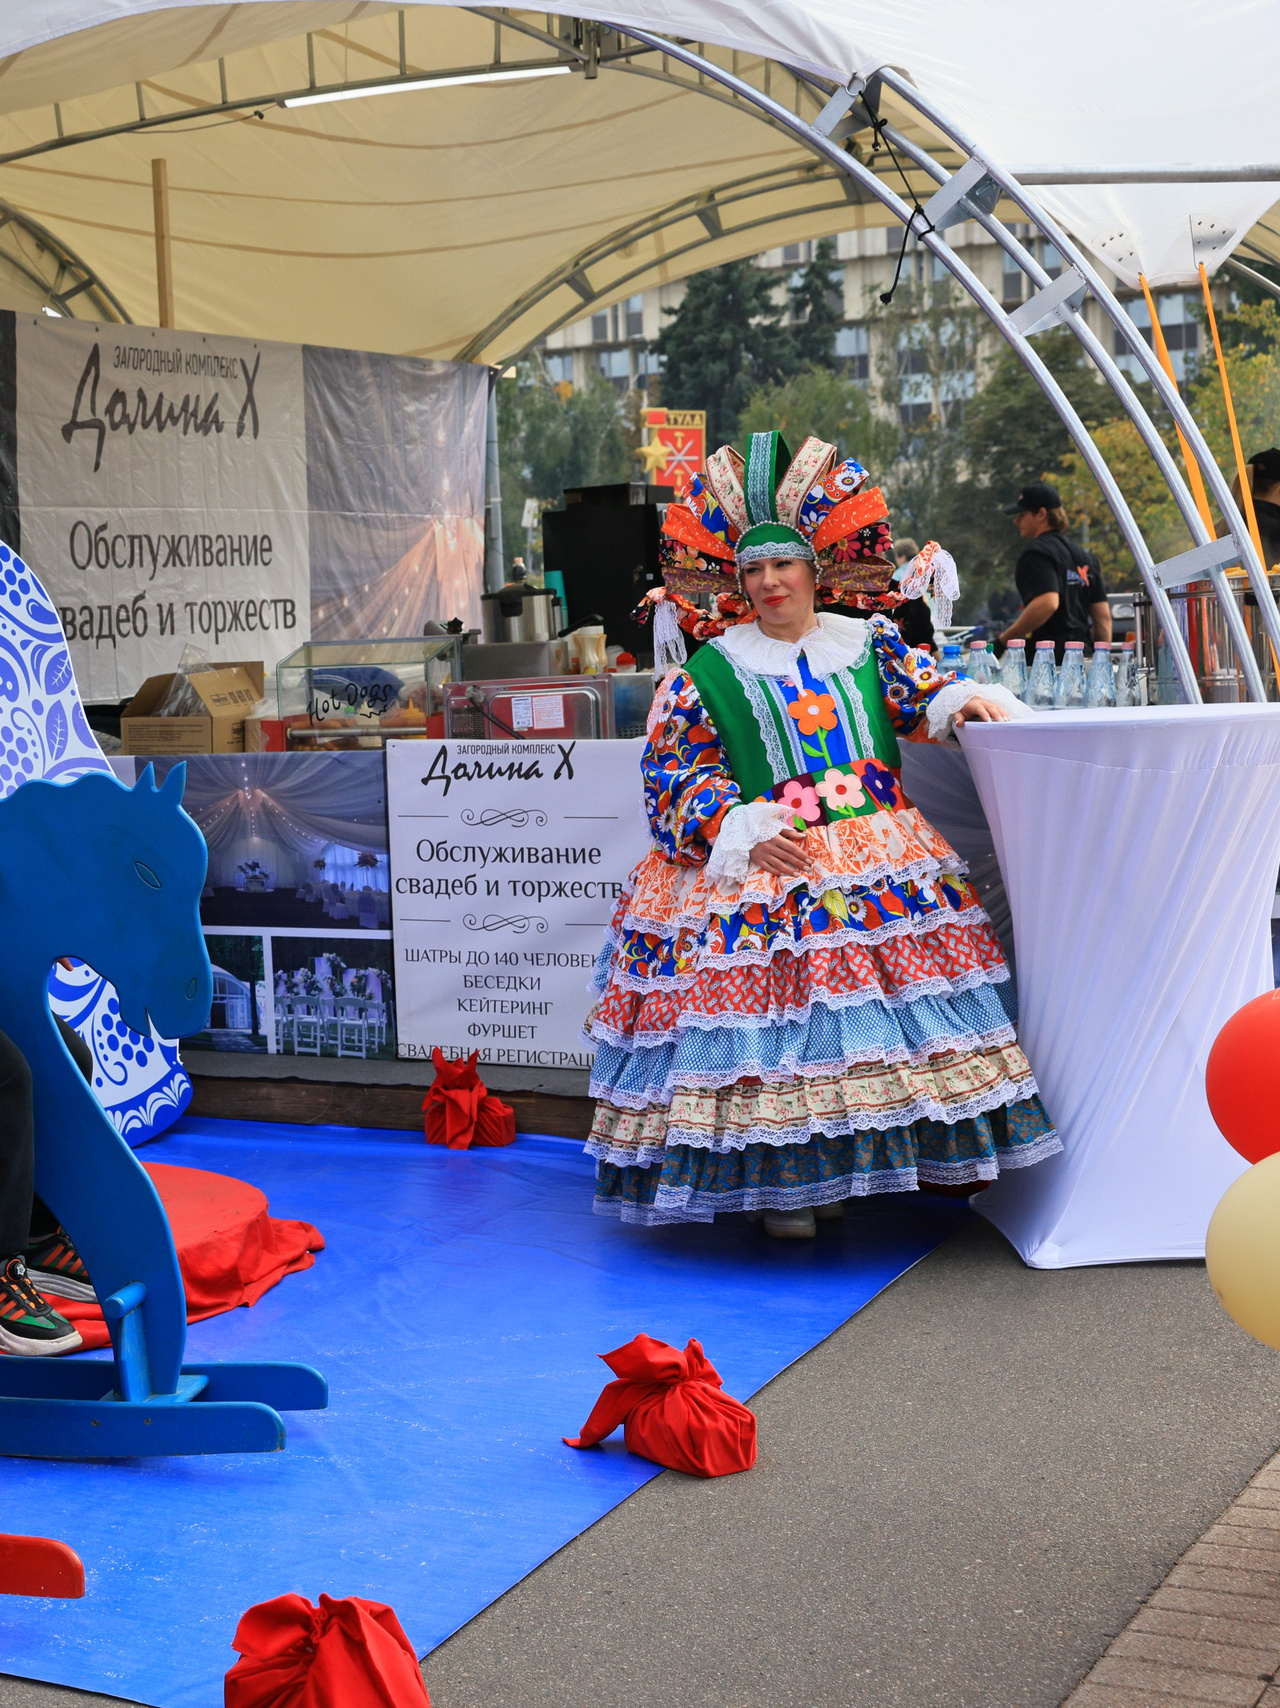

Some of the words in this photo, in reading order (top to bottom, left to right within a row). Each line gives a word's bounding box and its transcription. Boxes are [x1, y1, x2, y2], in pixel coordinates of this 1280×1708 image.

[113, 345, 183, 375] ЗАГОРОДНЫЙ
[185, 353, 238, 379] КОМПЛЕКС
[61, 343, 225, 473] Долина
[70, 520, 273, 580] Обслуживание
[57, 590, 149, 650] вадеб
[156, 602, 175, 636] и
[184, 598, 297, 645] торжеств
[306, 688, 341, 727] Hot
[345, 683, 393, 708] Dogs
[456, 743, 510, 756] ЗАГОРОДНЫЙ
[512, 744, 556, 755] КОМПЛЕКС
[421, 744, 544, 797] Долина
[416, 839, 602, 869] Обслуживание
[395, 873, 478, 900] свадеб
[484, 879, 500, 897] и
[508, 880, 623, 903] торжеств
[404, 948, 463, 964] ШАТРЫ
[466, 951, 490, 967] ДО
[494, 951, 519, 966] 140
[463, 974, 541, 992] БЕСЕДКИ
[456, 997, 553, 1016] КЕЙТЕРИНГ
[467, 1022, 538, 1039] ФУРШЕТ
[497, 1048, 595, 1070] РЕГИСТРАЦ
